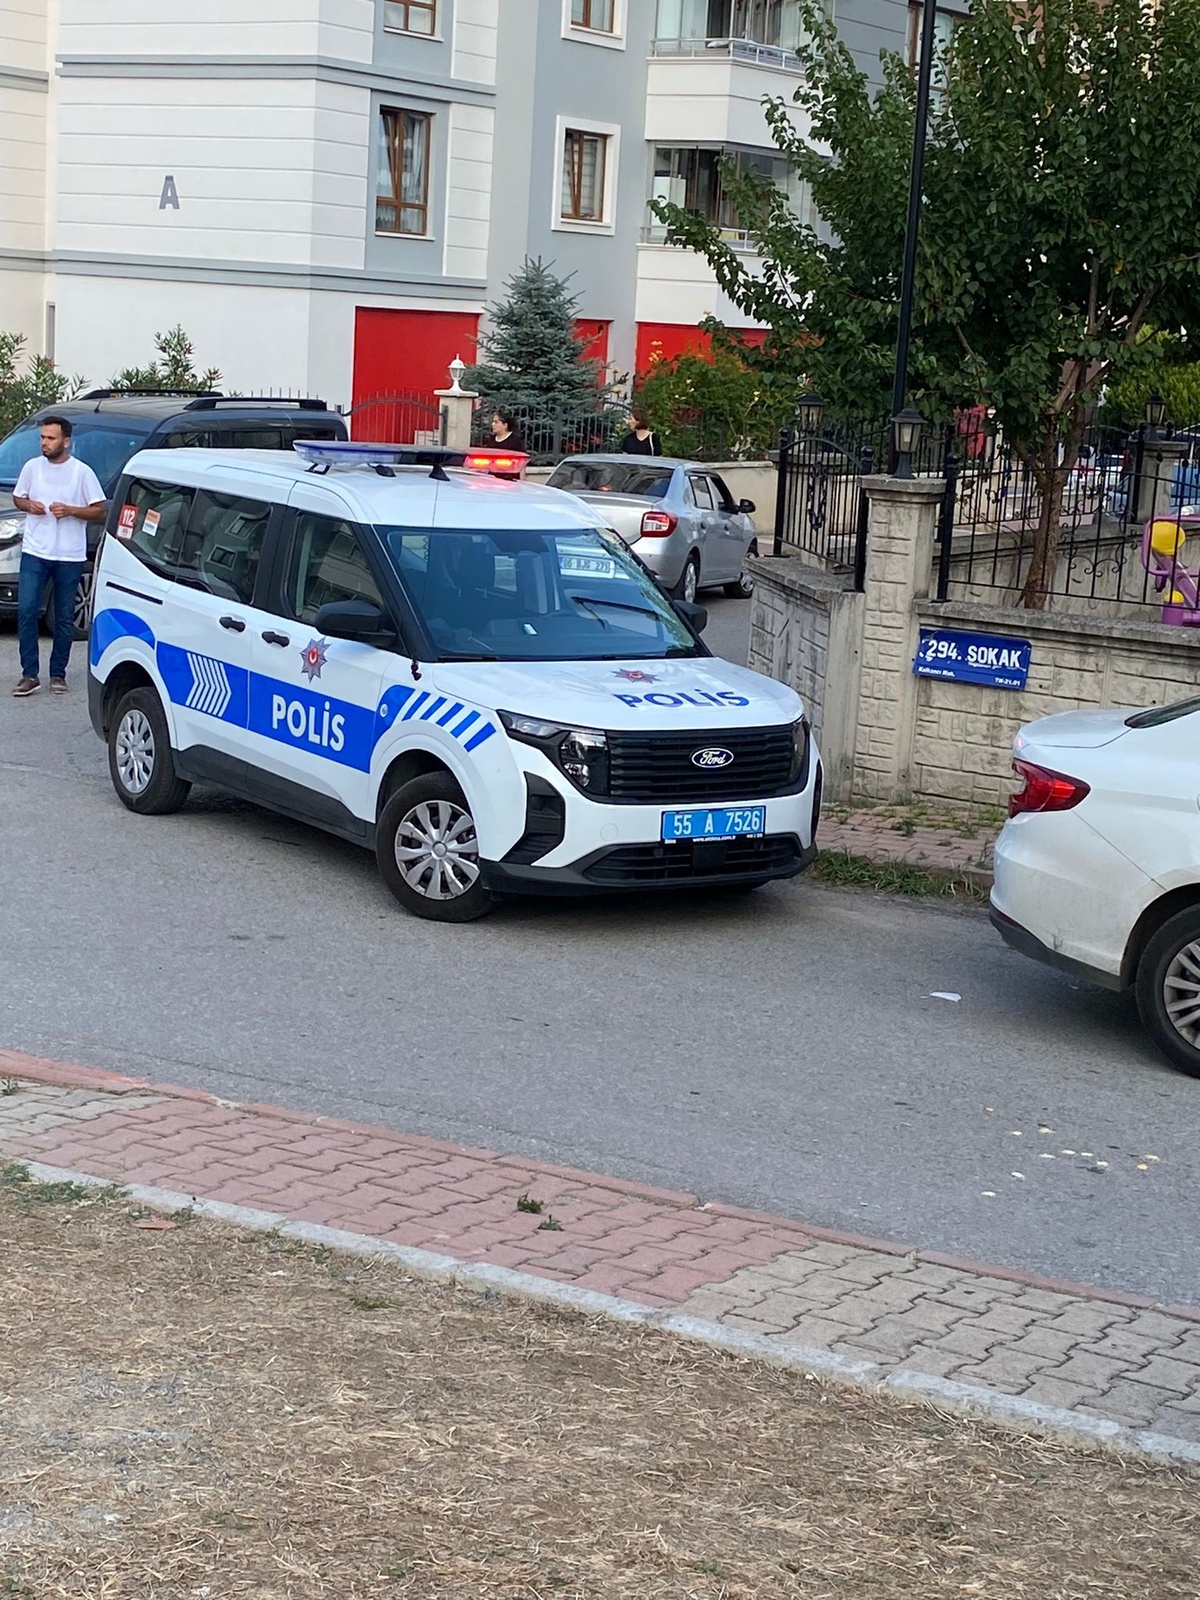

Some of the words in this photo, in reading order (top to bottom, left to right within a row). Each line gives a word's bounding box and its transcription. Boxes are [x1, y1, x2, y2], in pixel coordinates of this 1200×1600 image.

[159, 175, 180, 210] A
[122, 508, 136, 527] 112
[926, 639, 962, 660] 294.
[966, 645, 1022, 668] SOKAK
[612, 688, 750, 708] POLİS
[271, 693, 346, 752] POLİS
[699, 750, 727, 766] Ford
[673, 814, 693, 836] 55
[704, 812, 714, 834] A
[725, 810, 761, 833] 7526
